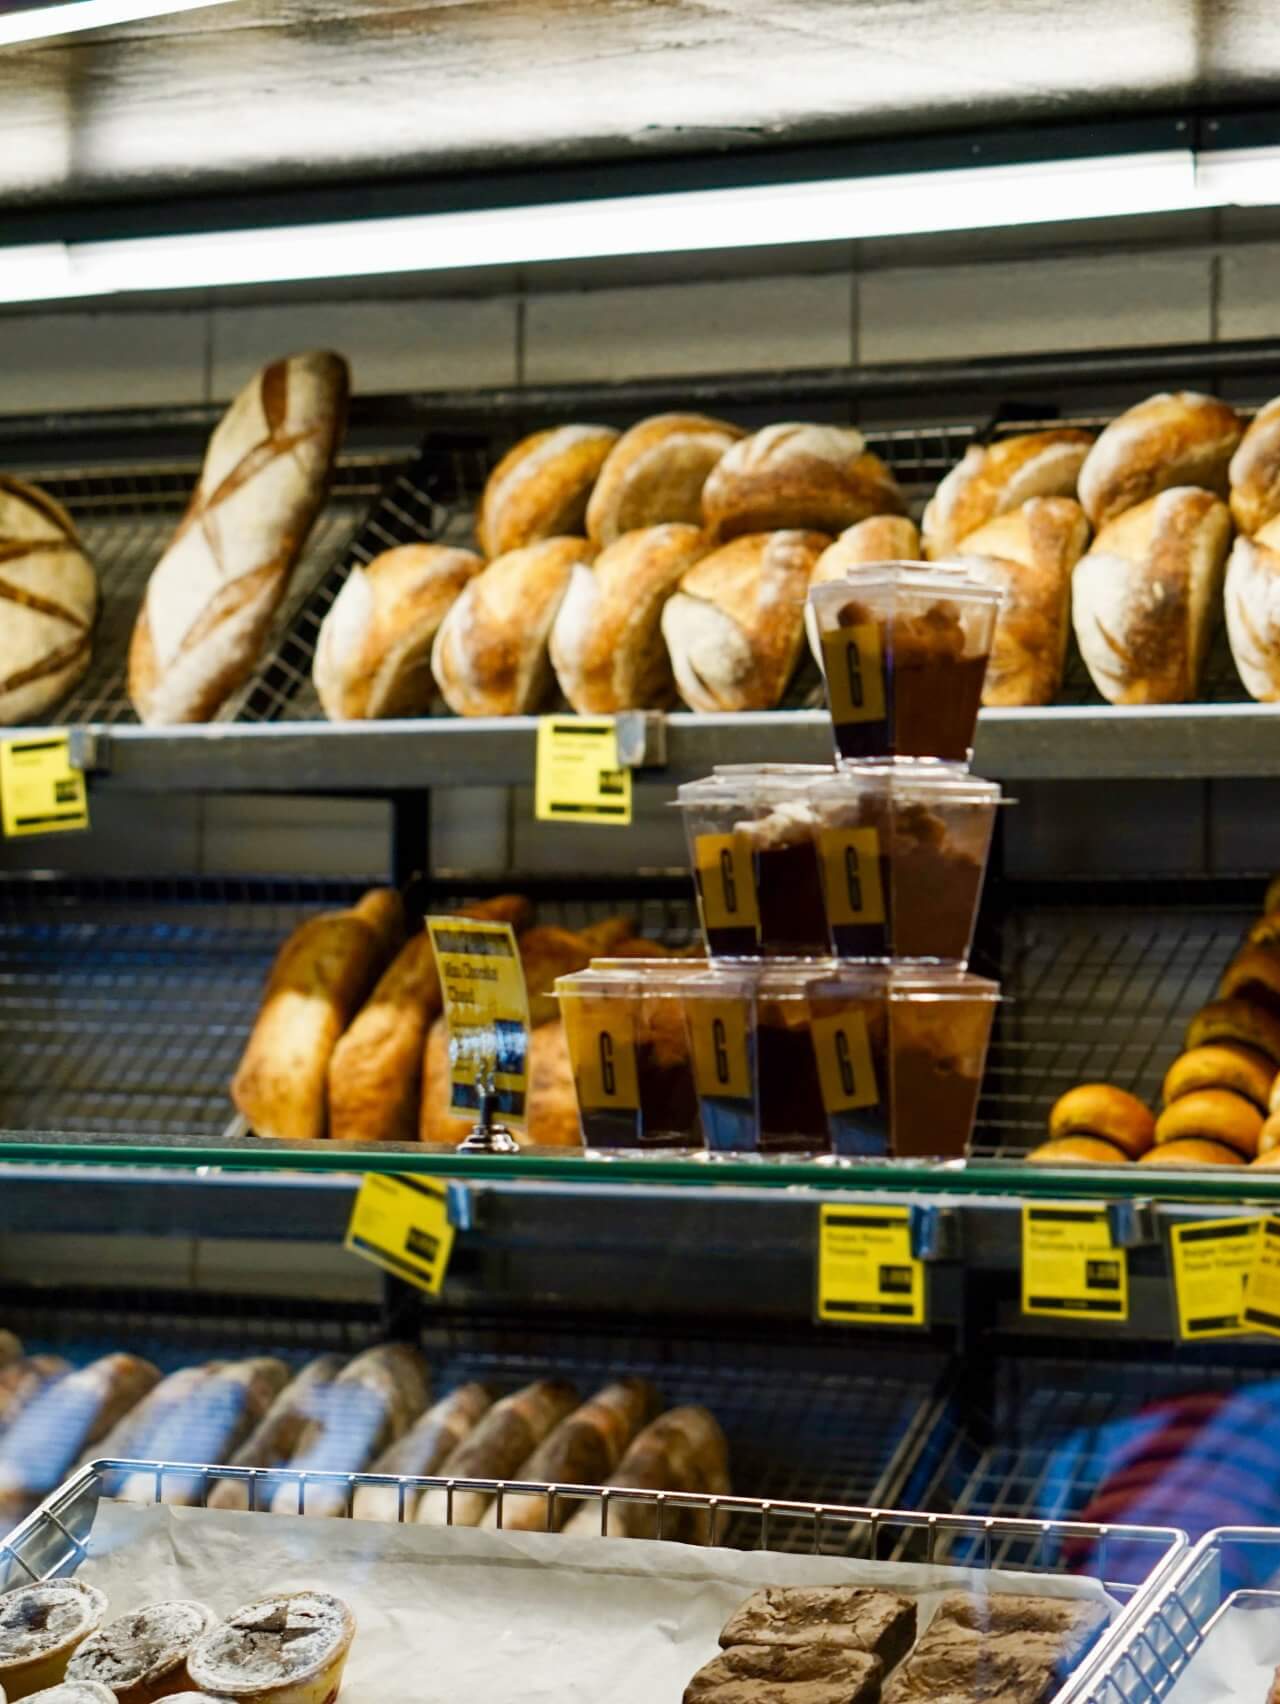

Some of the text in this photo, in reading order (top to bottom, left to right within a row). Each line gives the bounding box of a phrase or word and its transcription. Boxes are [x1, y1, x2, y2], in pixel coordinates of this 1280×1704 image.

[847, 640, 864, 708] G
[721, 848, 737, 914] G
[846, 845, 863, 912] G
[599, 1029, 617, 1095] G
[713, 1018, 731, 1085] G
[835, 1028, 856, 1097] G
